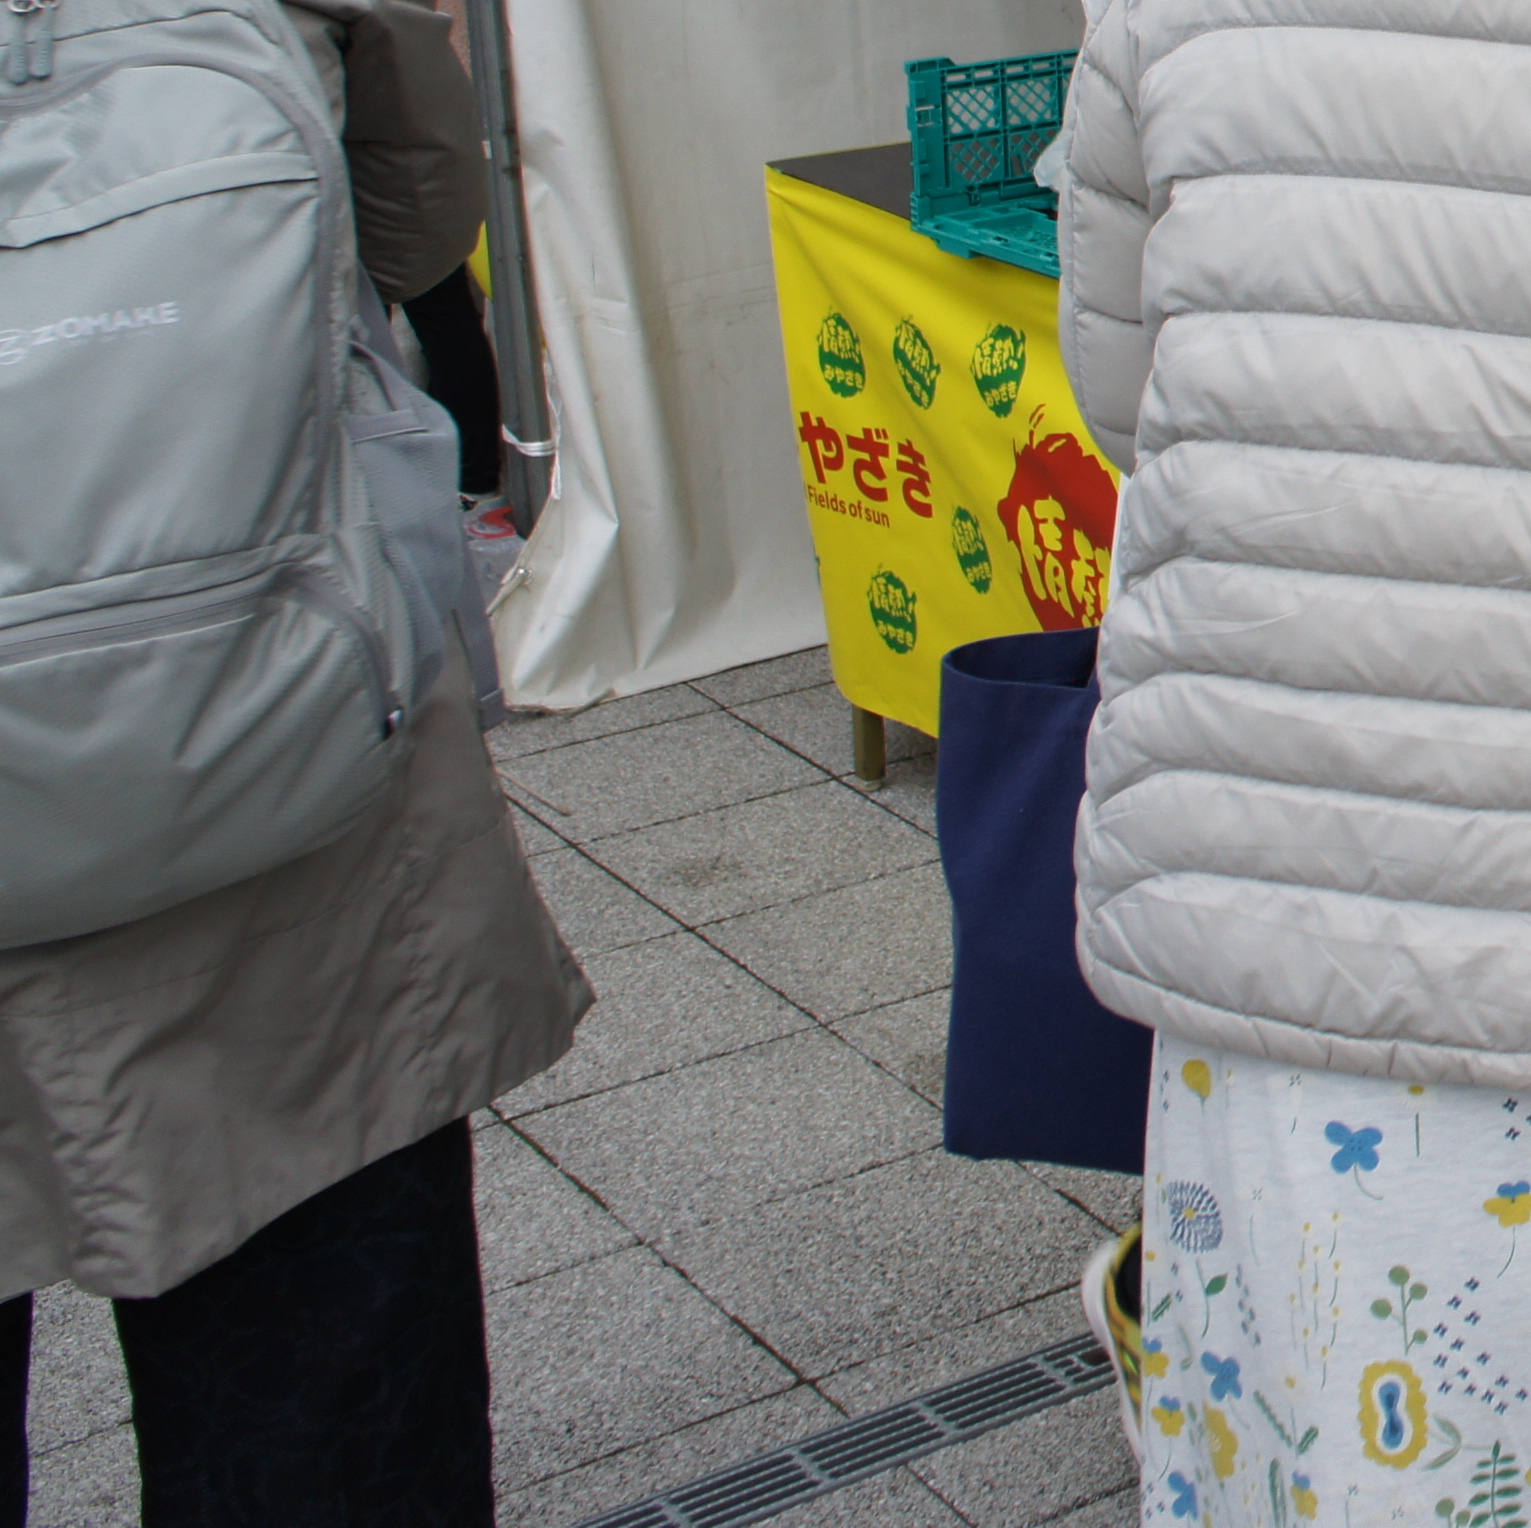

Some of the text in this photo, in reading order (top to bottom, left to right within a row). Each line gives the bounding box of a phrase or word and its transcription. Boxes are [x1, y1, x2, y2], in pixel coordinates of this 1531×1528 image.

[807, 483, 891, 529] Fields of sun
